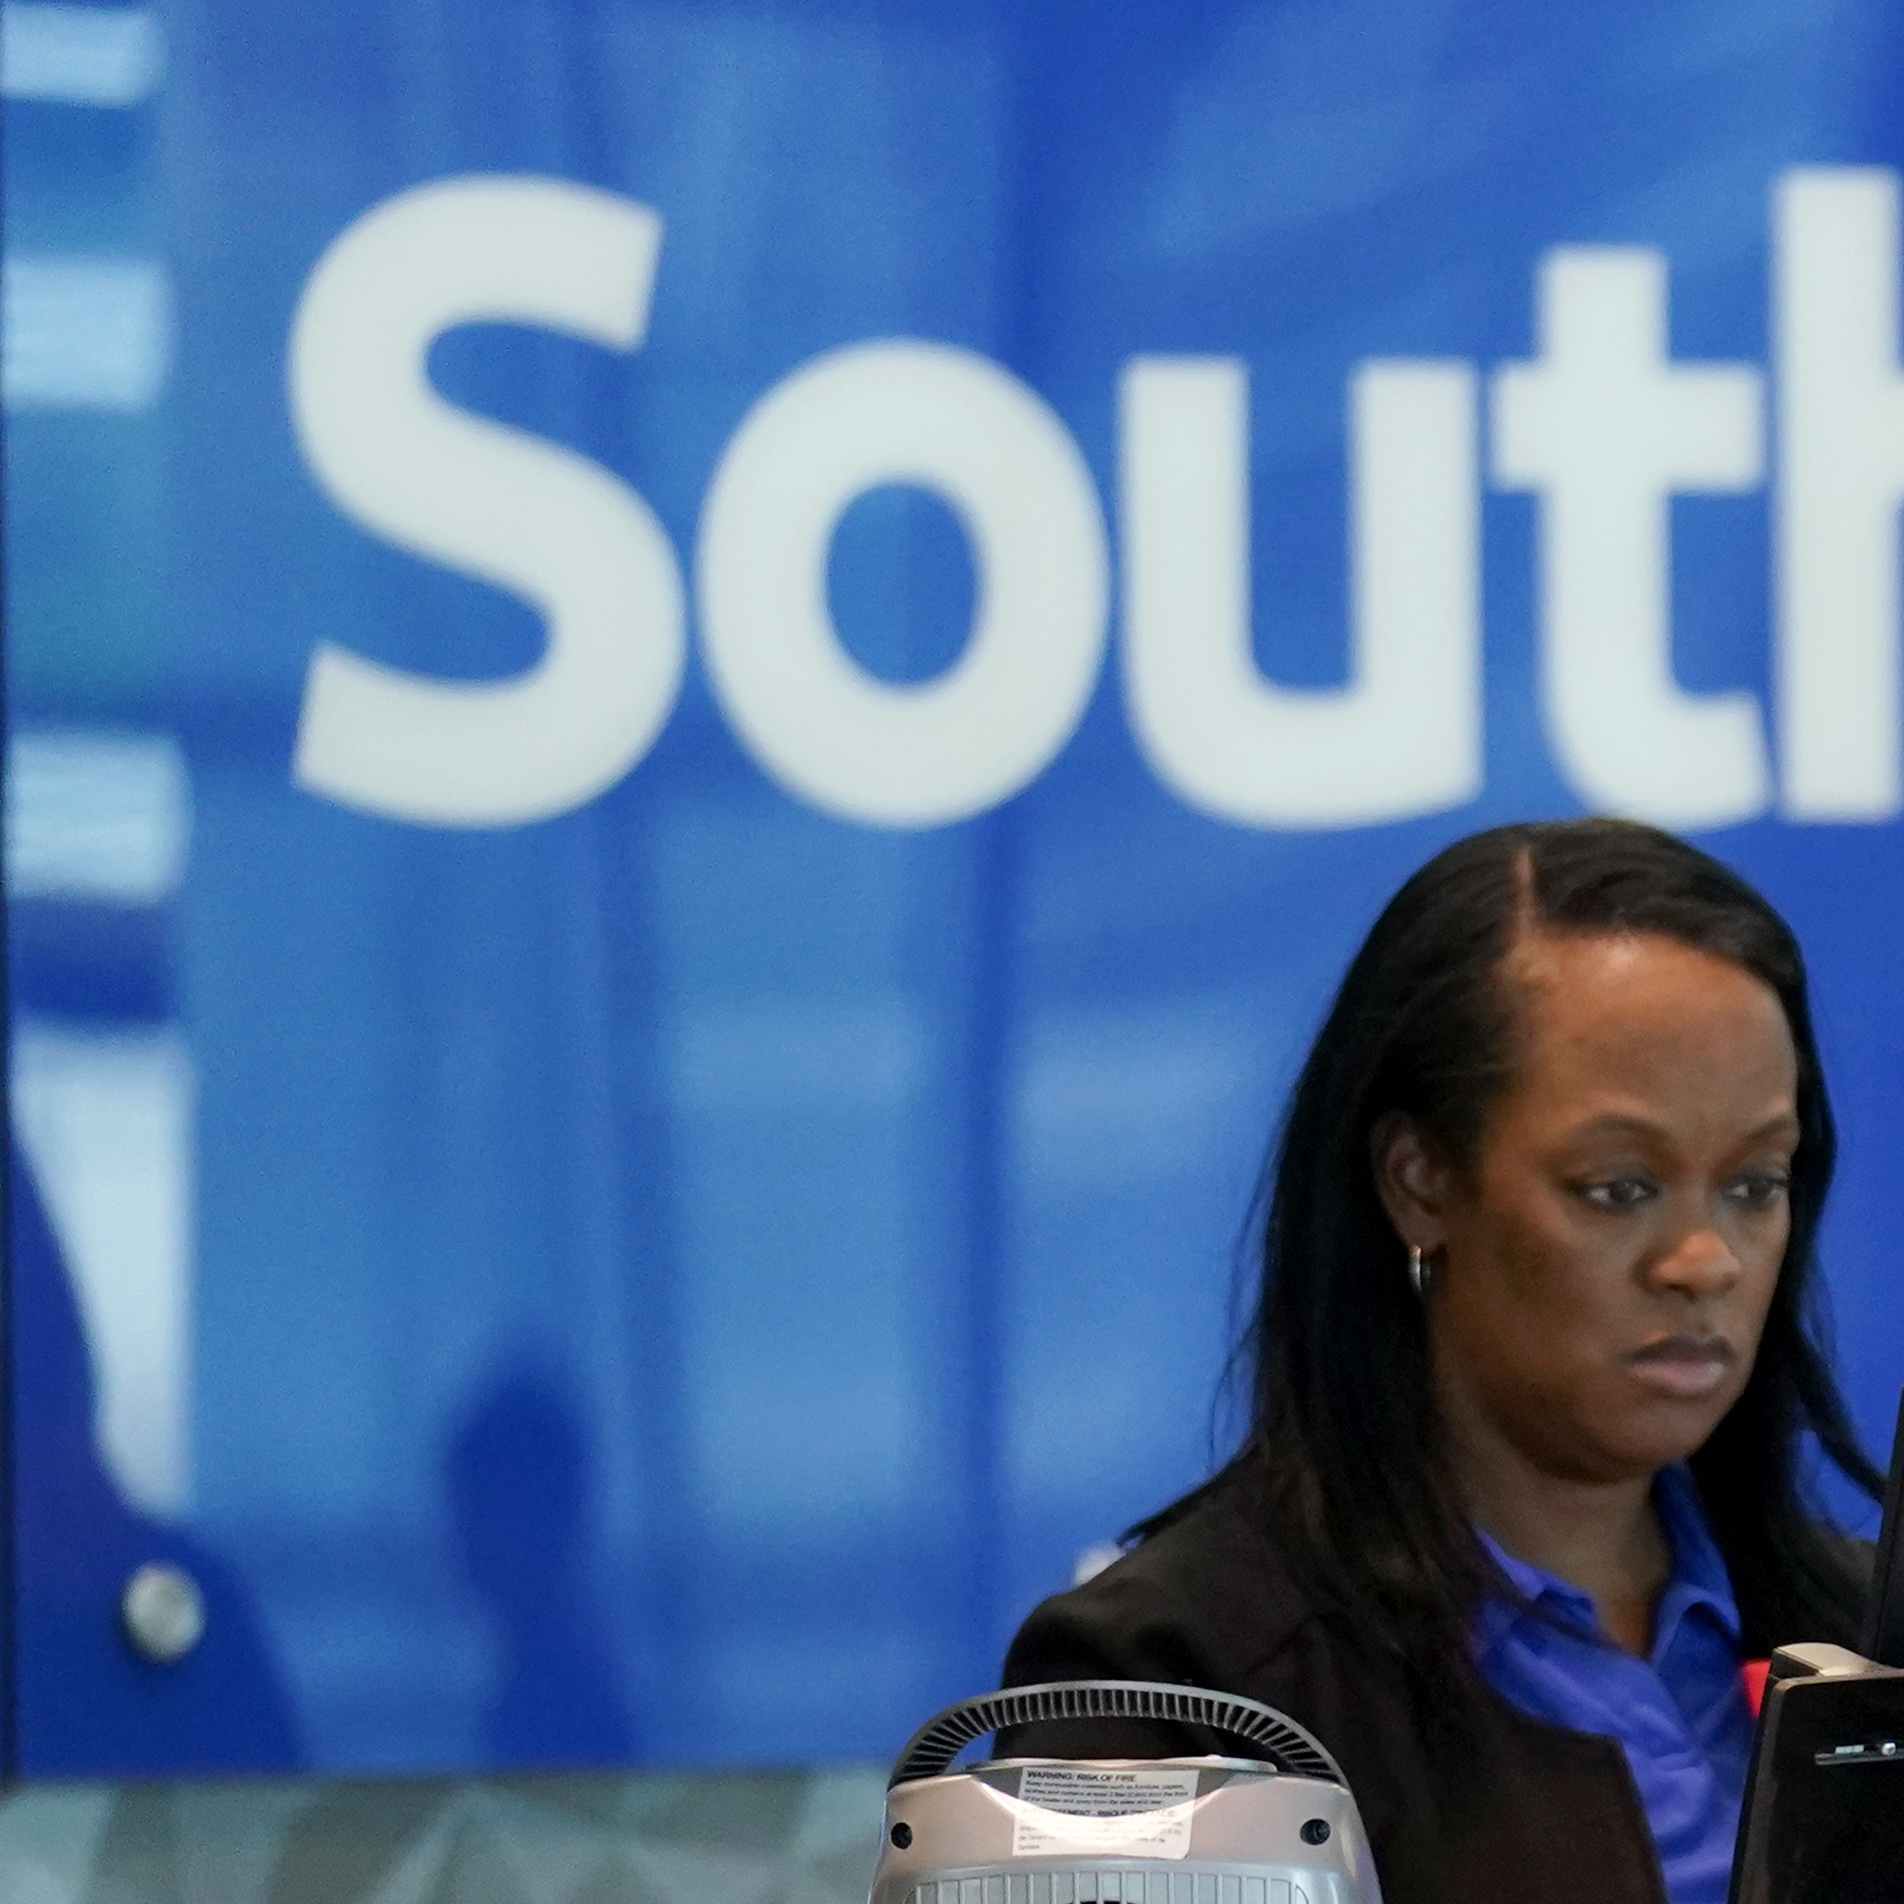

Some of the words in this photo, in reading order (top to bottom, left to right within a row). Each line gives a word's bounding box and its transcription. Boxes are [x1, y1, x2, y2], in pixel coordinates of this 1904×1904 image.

[1027, 1770, 1074, 1780] WARNING:
[1077, 1772, 1099, 1781] RISK
[1101, 1773, 1112, 1782] OF
